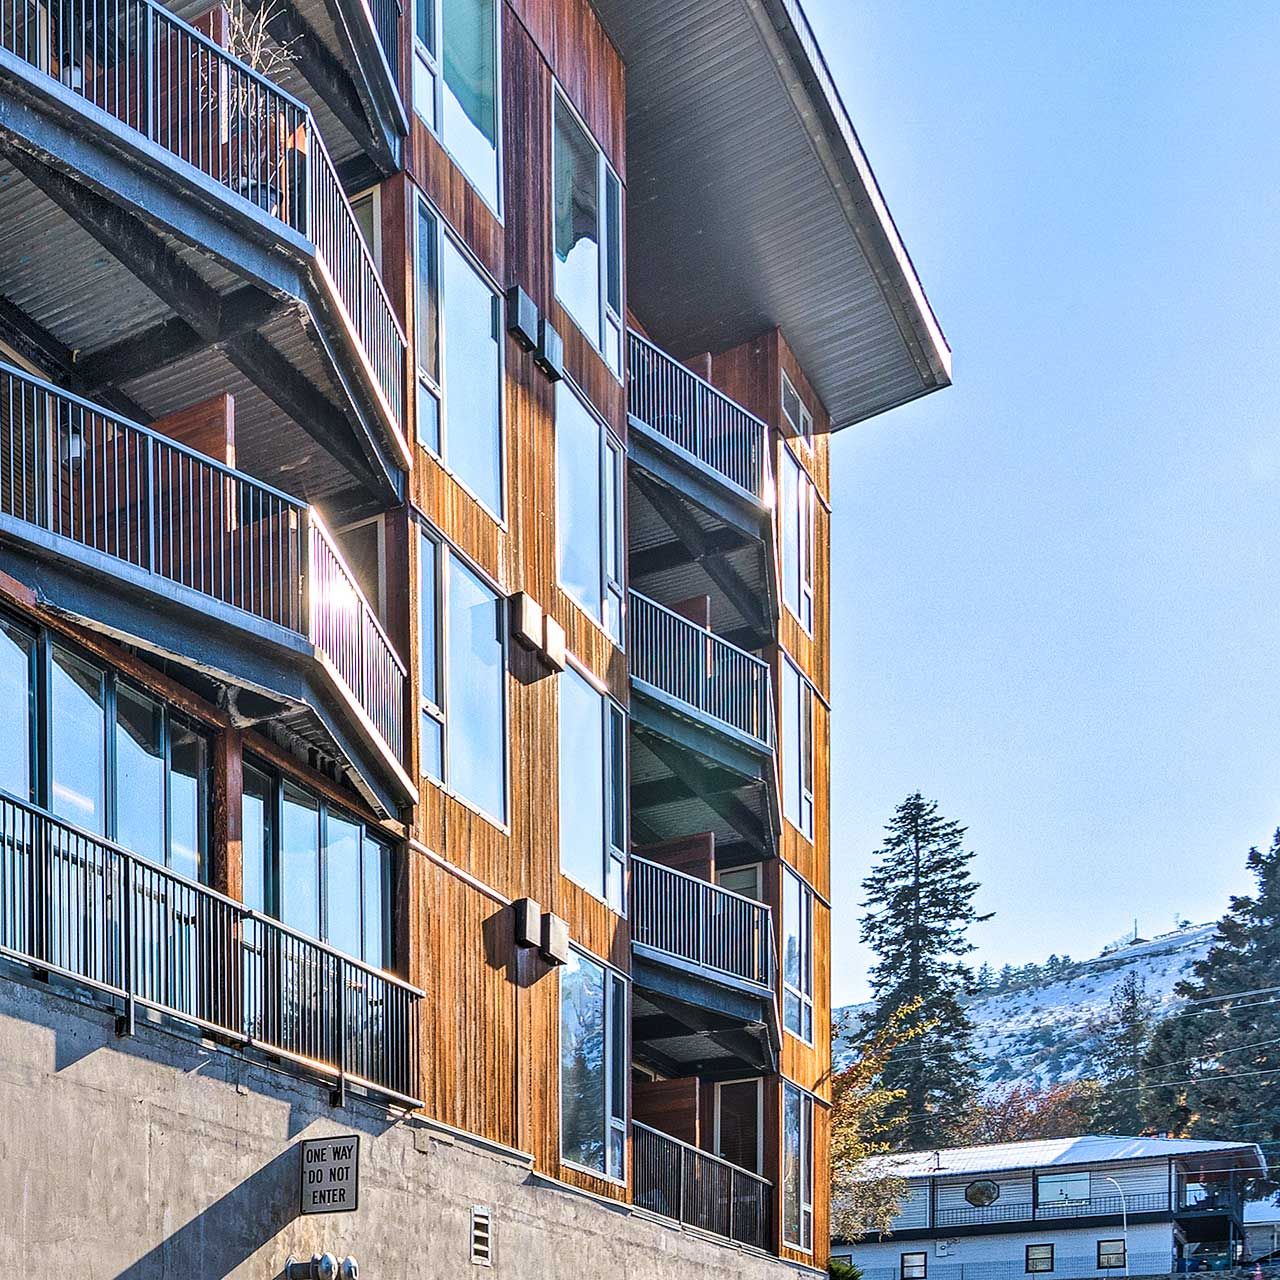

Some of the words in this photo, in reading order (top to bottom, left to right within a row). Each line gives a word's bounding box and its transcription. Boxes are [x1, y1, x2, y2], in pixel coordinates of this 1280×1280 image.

[306, 1147, 327, 1163] ONE
[332, 1145, 354, 1161] WAY
[308, 1169, 323, 1184] DO
[329, 1167, 351, 1182] NOT
[312, 1188, 346, 1205] ENTER
